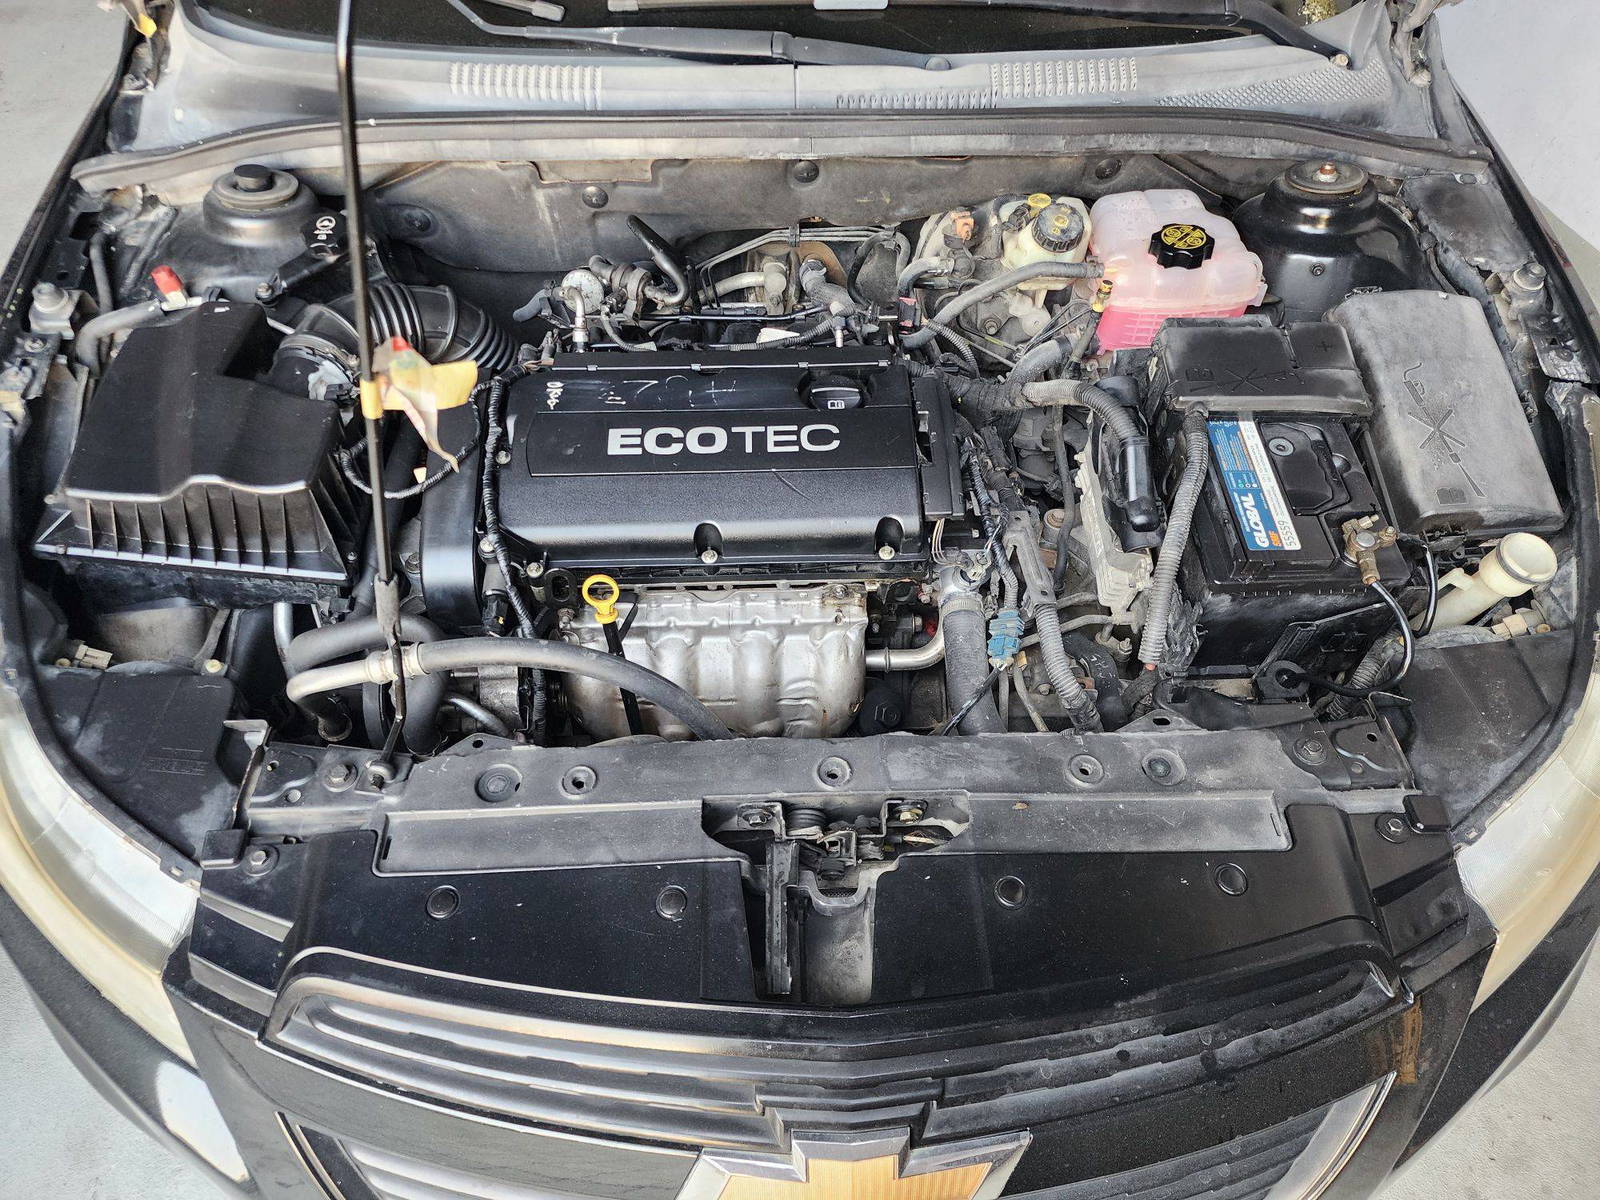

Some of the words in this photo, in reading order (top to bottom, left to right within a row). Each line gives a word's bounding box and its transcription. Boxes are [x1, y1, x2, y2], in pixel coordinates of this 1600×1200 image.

[607, 423, 841, 456] ECOTEC
[1240, 493, 1268, 548] GLOBAL
[1278, 520, 1296, 547] 55559
